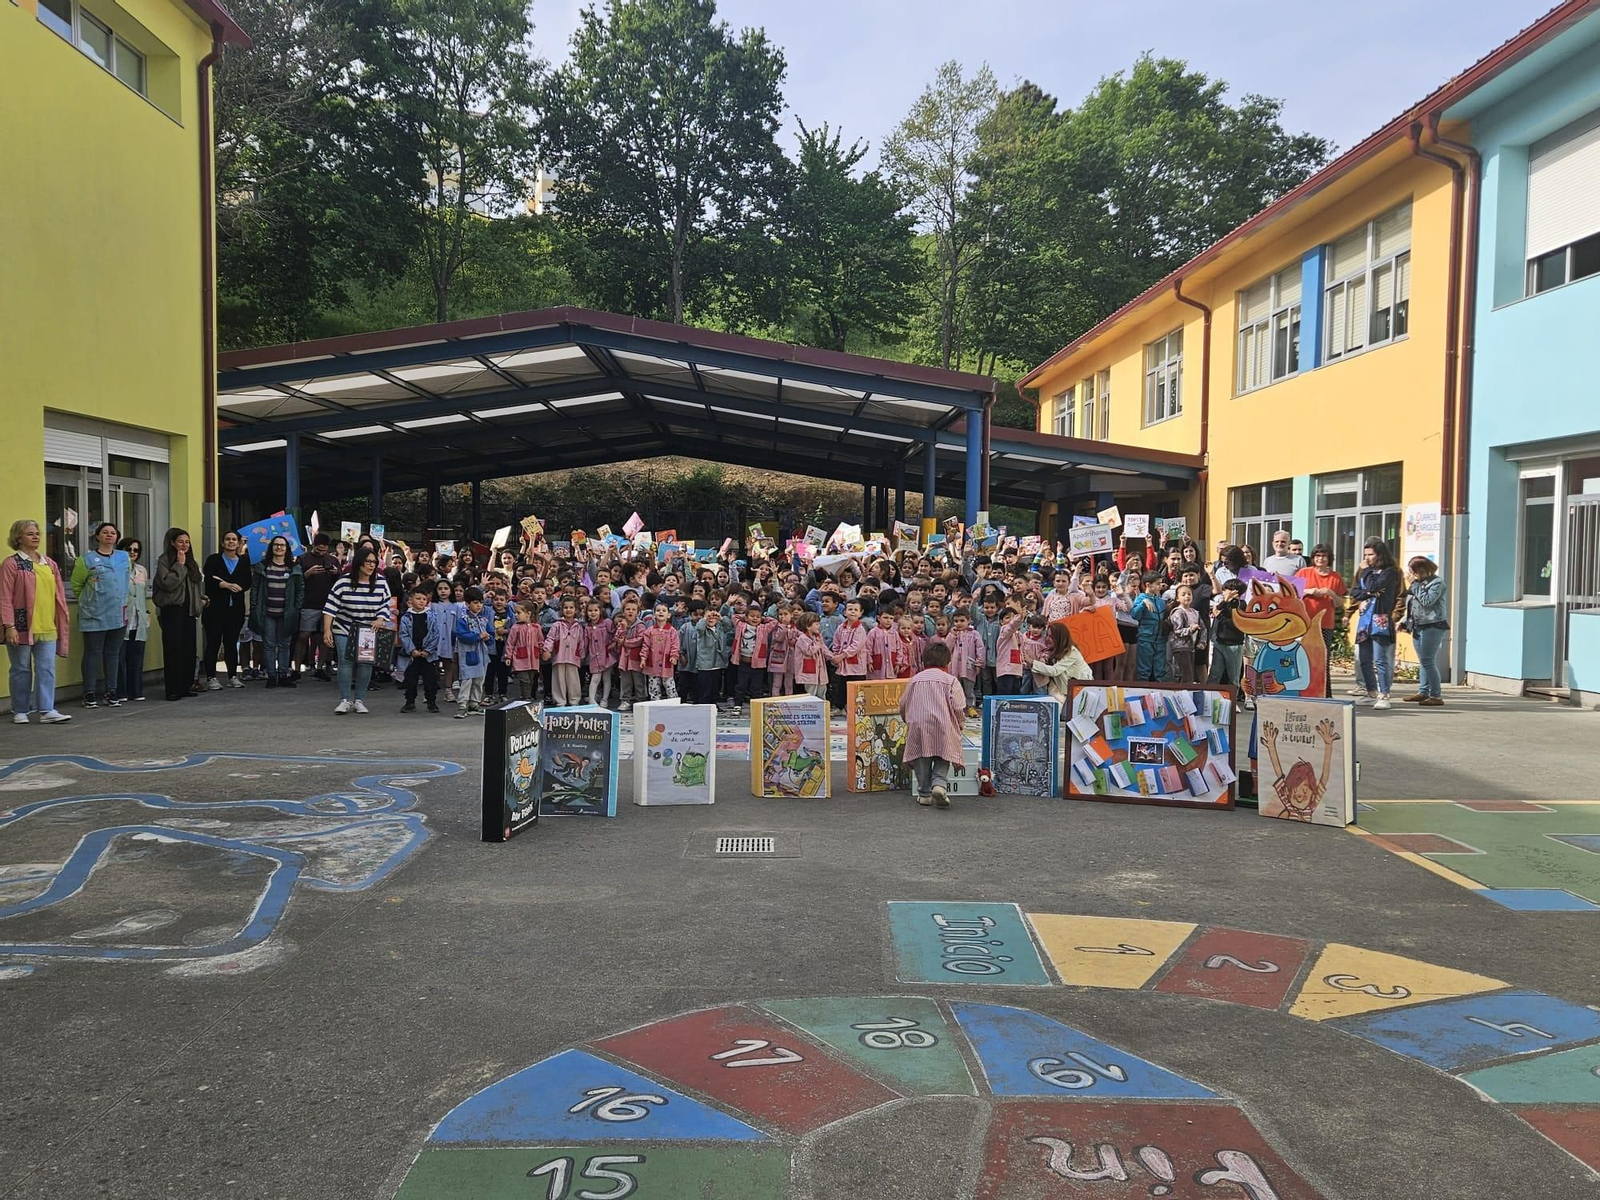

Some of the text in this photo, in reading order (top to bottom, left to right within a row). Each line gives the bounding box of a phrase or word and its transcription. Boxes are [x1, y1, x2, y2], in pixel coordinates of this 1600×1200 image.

[543, 714, 610, 734] Harry Potter
[1322, 973, 1413, 1000] 3
[850, 1016, 939, 1050] 18
[709, 1038, 804, 1068] 17
[1026, 1050, 1129, 1090] 19
[565, 1085, 669, 1123] 16
[525, 1154, 647, 1200] 15
